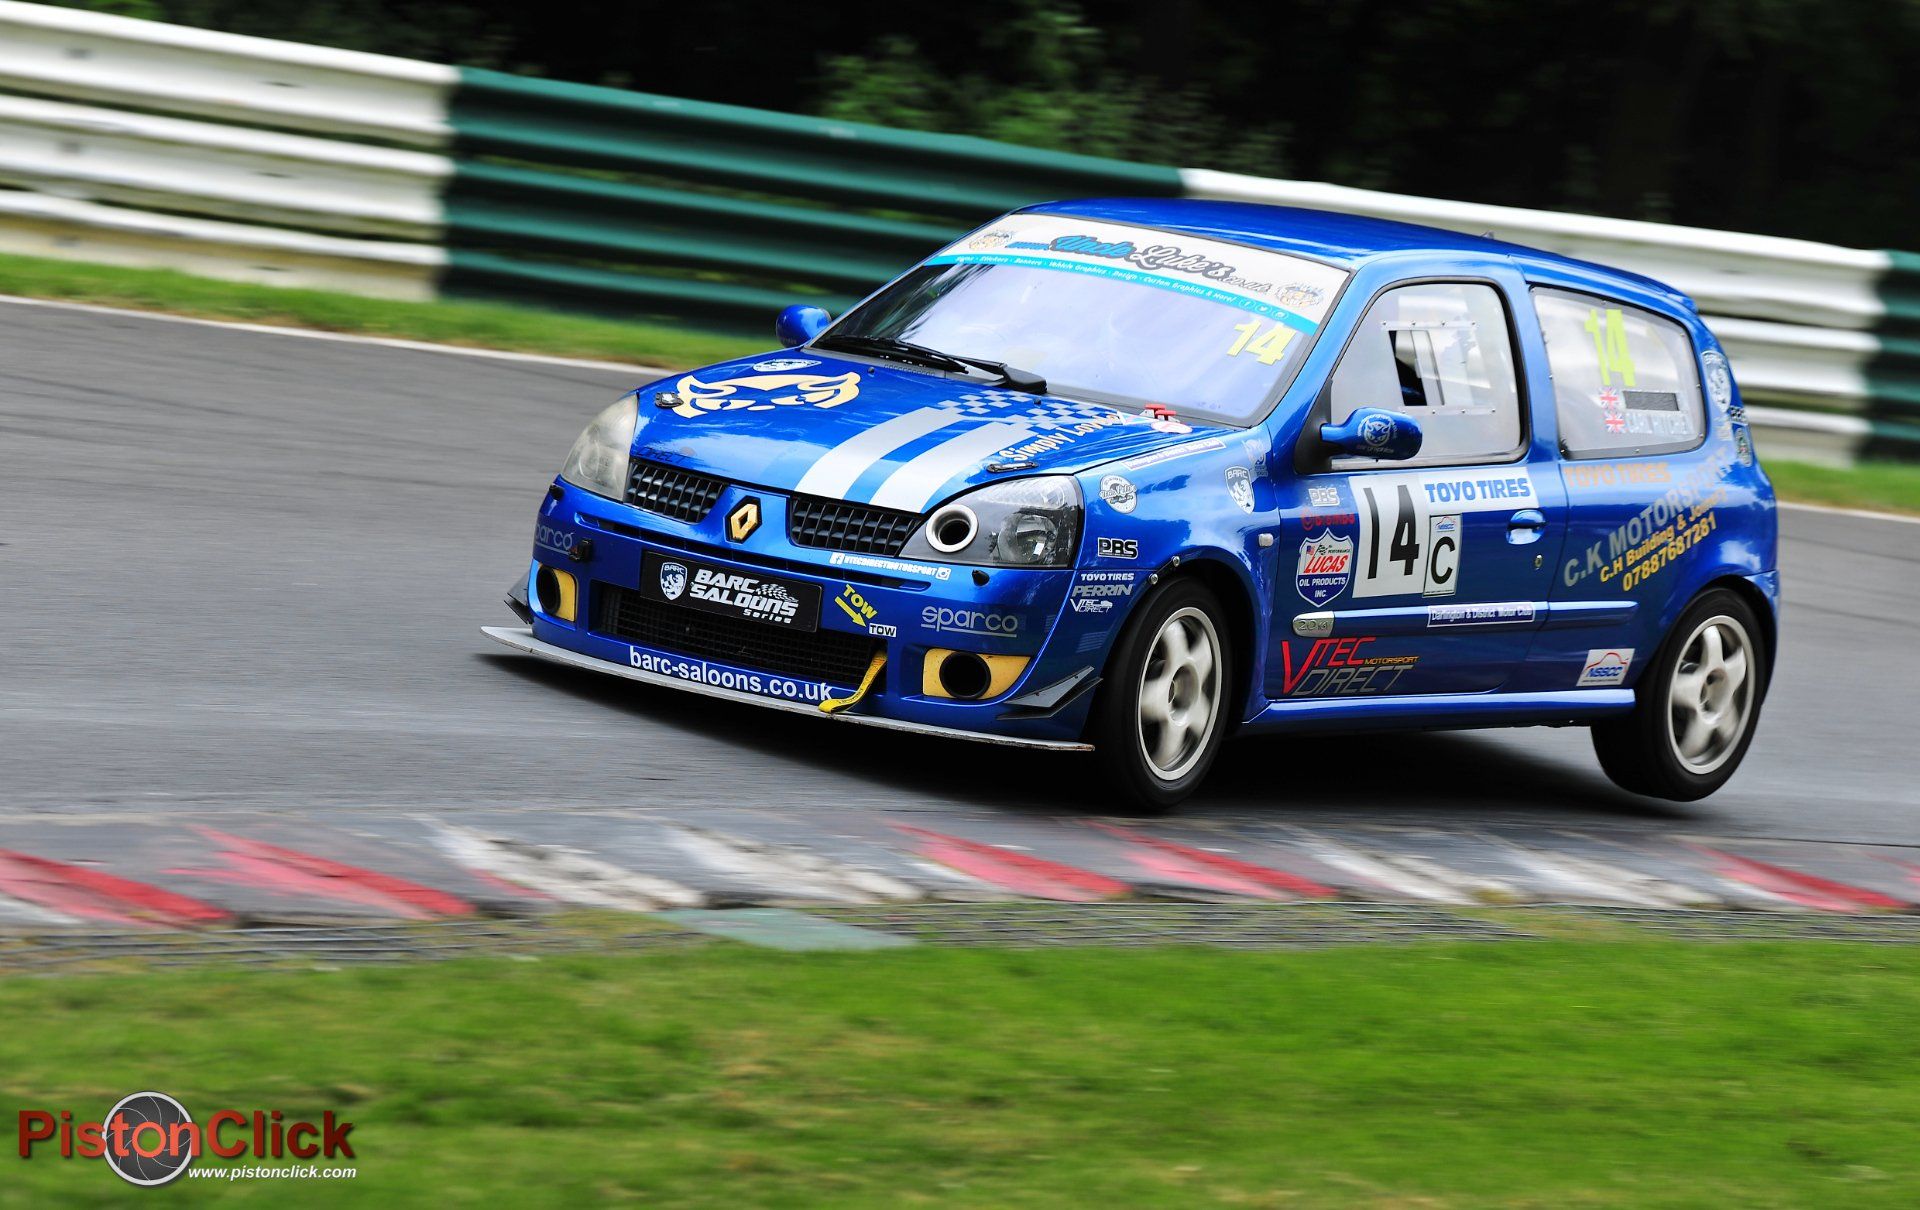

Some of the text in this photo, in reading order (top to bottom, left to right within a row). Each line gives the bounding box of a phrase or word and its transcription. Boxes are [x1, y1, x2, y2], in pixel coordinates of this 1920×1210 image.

[1075, 264, 1107, 275] Graphics
[1113, 271, 1137, 281] Design
[1143, 277, 1170, 287] Custom
[1172, 283, 1204, 295] Graphics
[1227, 320, 1297, 366] 14
[1584, 309, 1636, 386] 14
[999, 432, 1076, 461] Simply
[1227, 468, 1248, 479] BARC
[1563, 464, 1615, 487] TOYO
[1424, 477, 1531, 503] TOYO TIRES
[1363, 484, 1420, 579] 14
[1430, 536, 1455, 584] C
[1600, 556, 1623, 583] C.H
[1626, 525, 1674, 566] Building
[1677, 513, 1687, 530] &
[664, 564, 685, 575] BARC
[1081, 572, 1134, 581] TOYO TIRES
[1303, 554, 1348, 574] LUCAS
[1563, 540, 1605, 587] C.K
[693, 568, 760, 593] BARC
[1071, 584, 1133, 597] PERRIN
[1299, 576, 1346, 587] OIL PRODUCTS
[1314, 589, 1326, 598] INC
[690, 582, 799, 617] SALOONS
[843, 584, 878, 619] TOW
[743, 608, 792, 624] Series
[870, 624, 896, 636] TOW
[921, 605, 1018, 634] sparco
[629, 645, 833, 701] barc-saloons.co.uk
[1281, 637, 1376, 695] VTEC
[1364, 655, 1420, 665] MOTORSPORT
[1291, 664, 1415, 696] DIRECT
